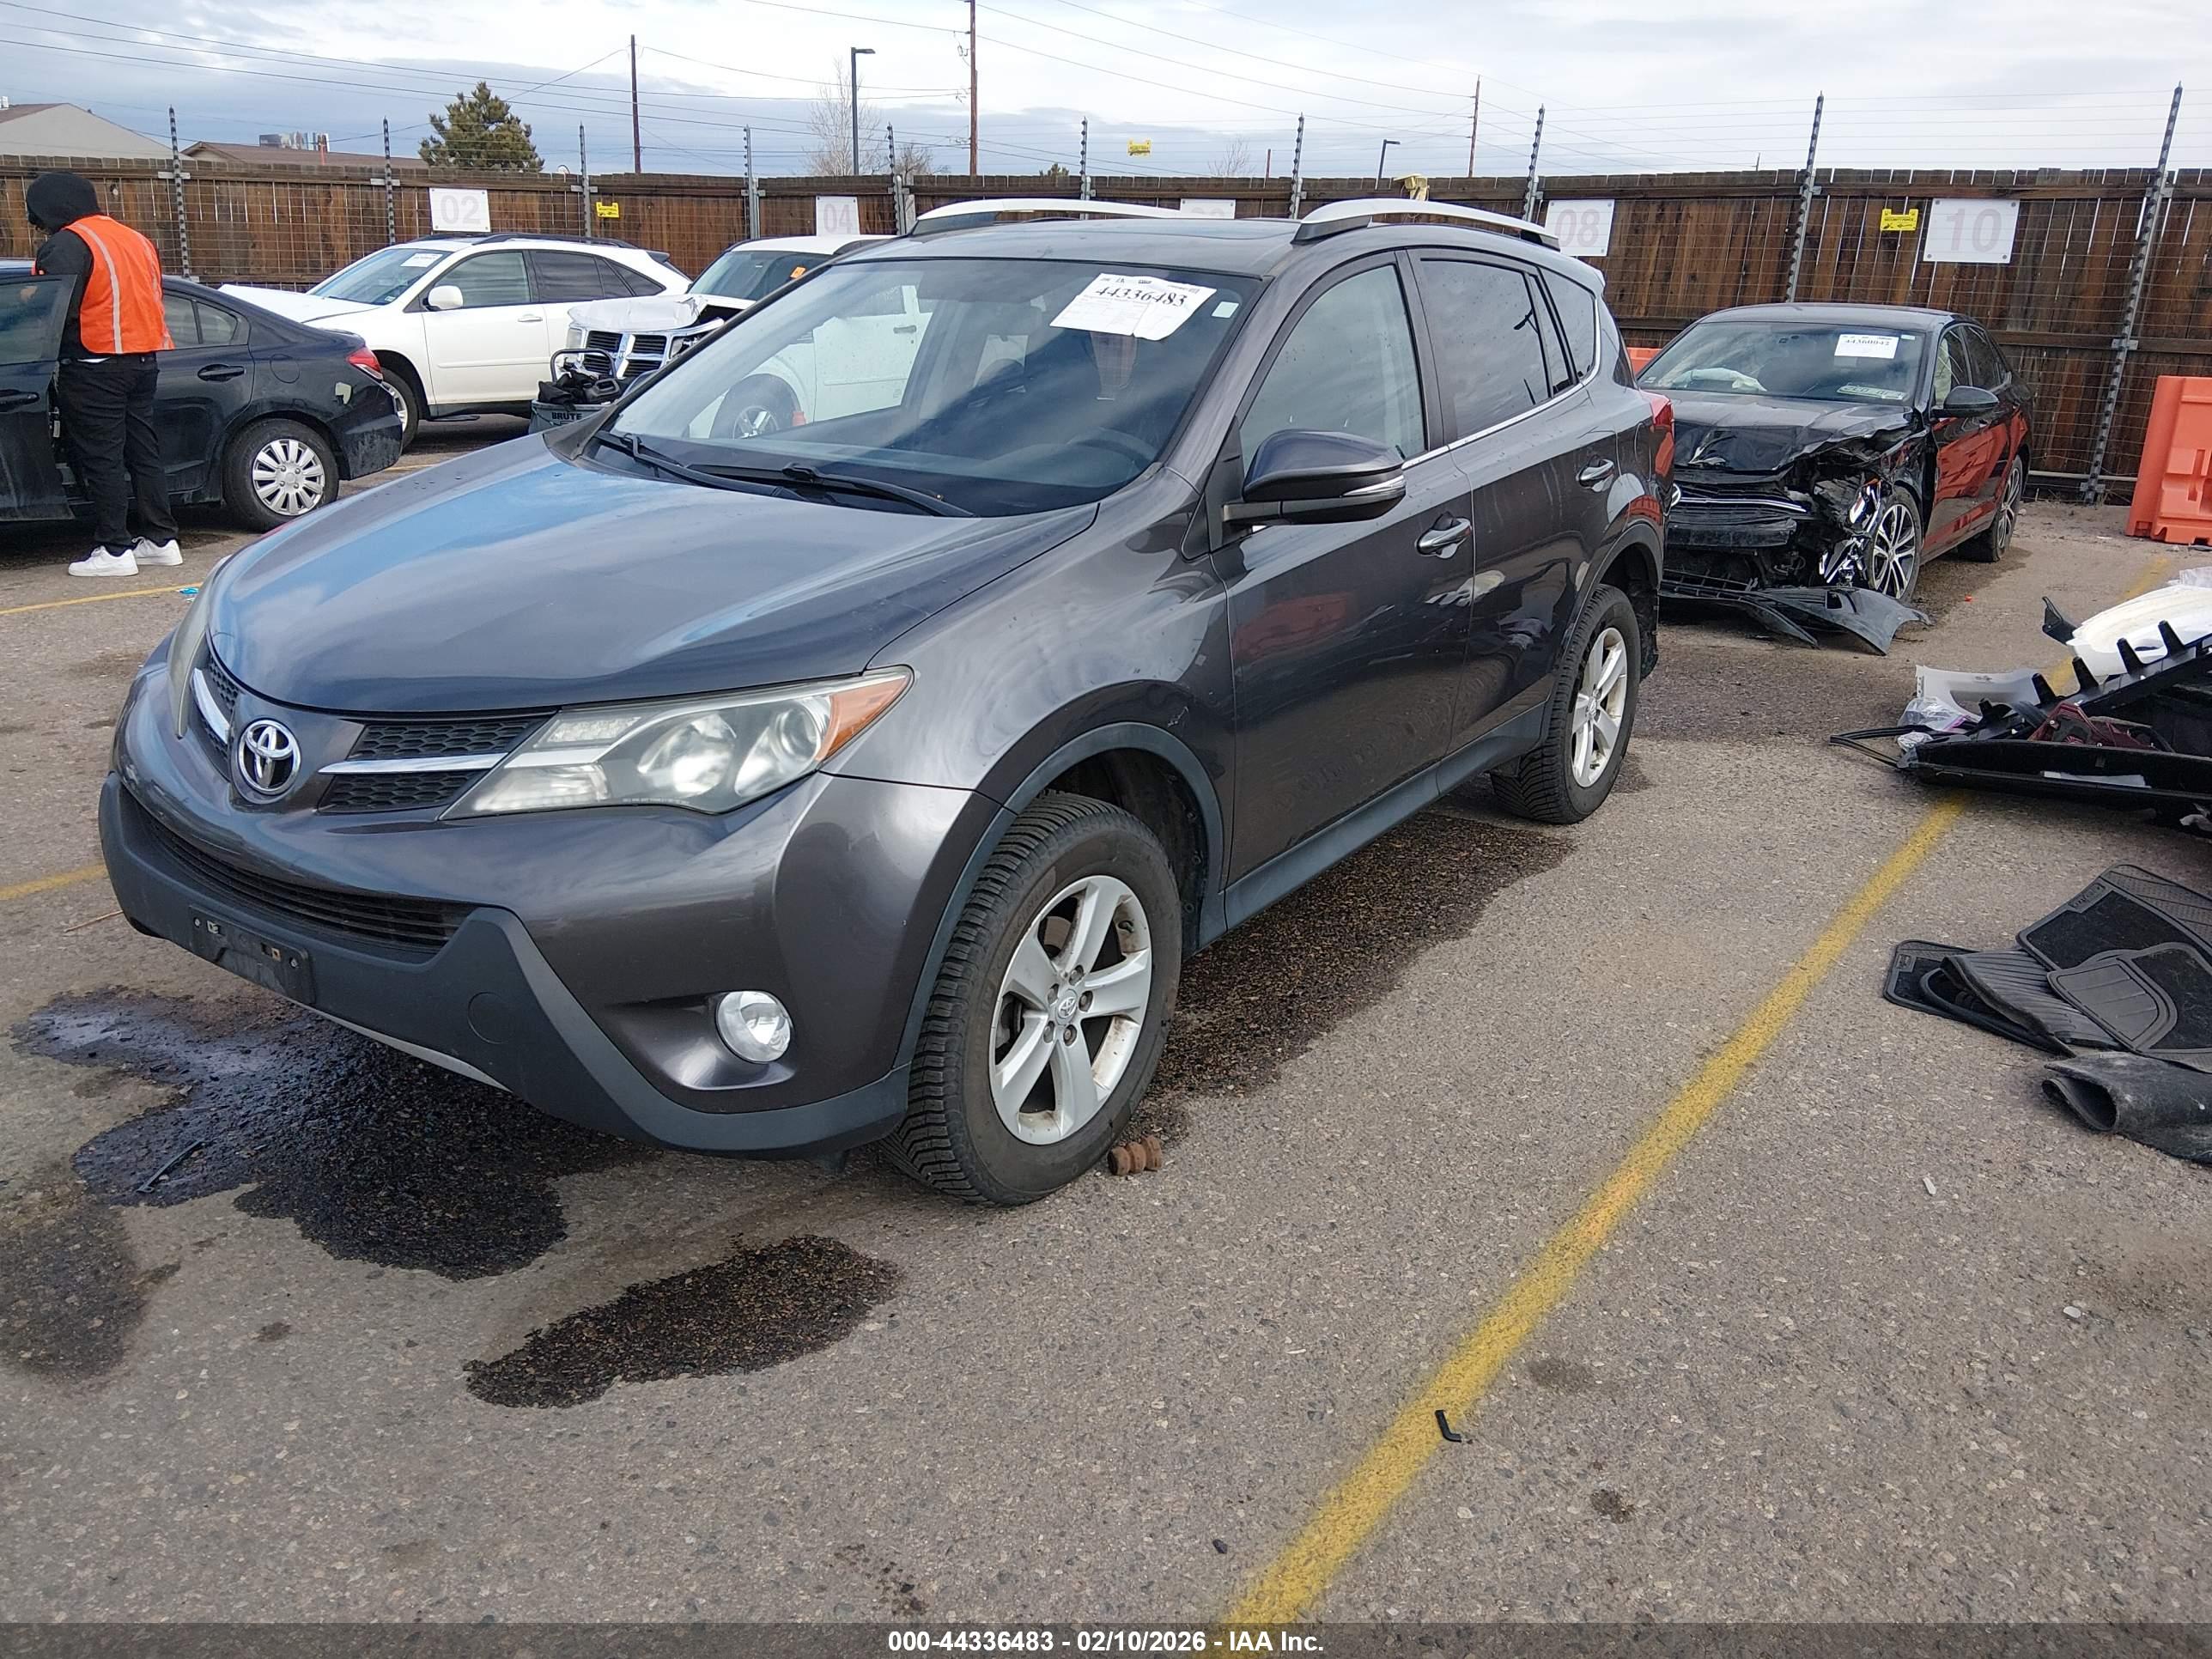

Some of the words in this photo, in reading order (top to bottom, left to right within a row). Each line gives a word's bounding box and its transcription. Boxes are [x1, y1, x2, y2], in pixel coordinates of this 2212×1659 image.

[441, 195, 481, 225] 02
[823, 204, 853, 234] 04
[1554, 209, 1600, 247] 08
[1945, 208, 2002, 252] 10
[1096, 285, 1188, 307] 44336483
